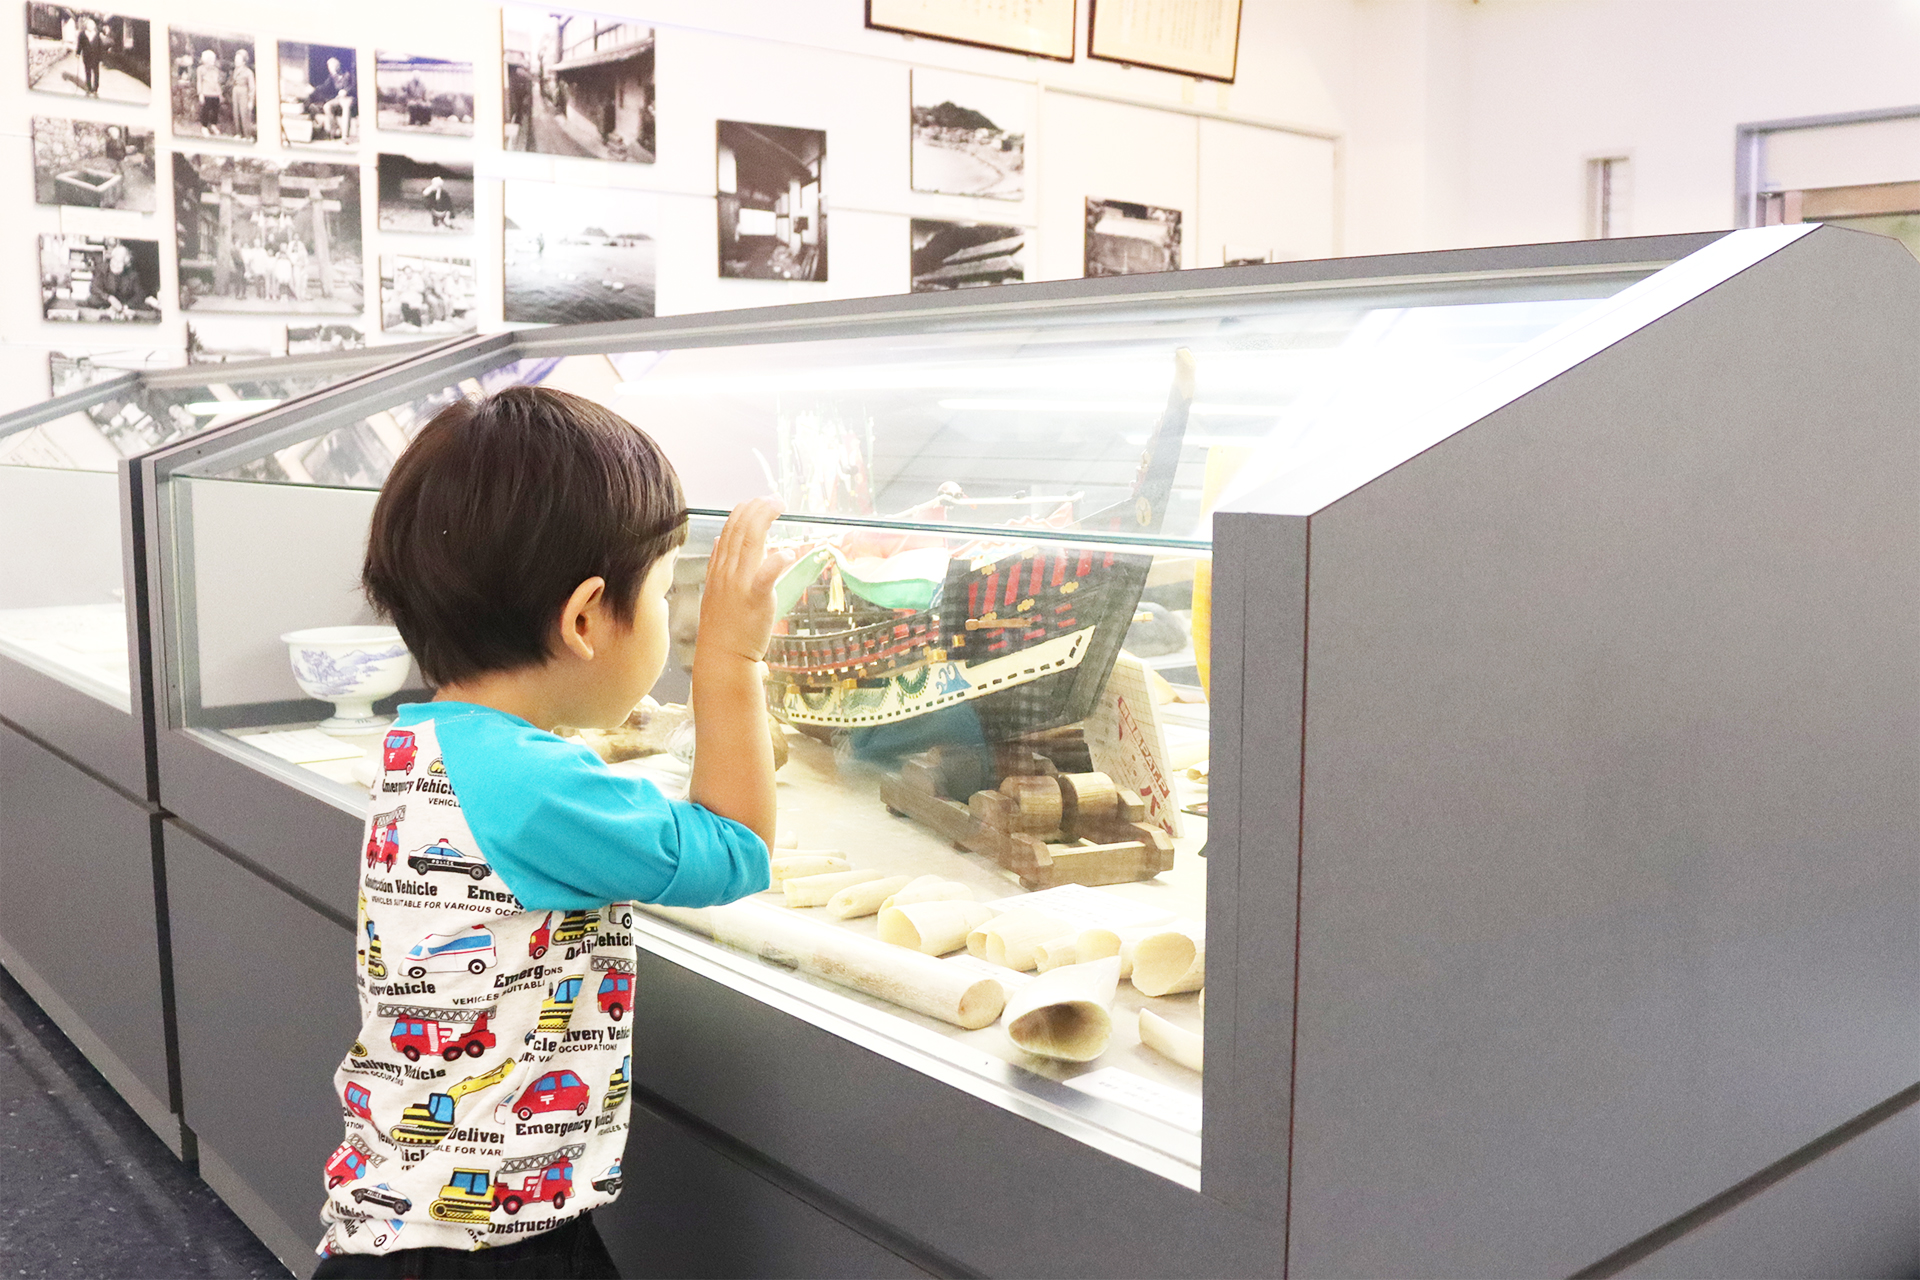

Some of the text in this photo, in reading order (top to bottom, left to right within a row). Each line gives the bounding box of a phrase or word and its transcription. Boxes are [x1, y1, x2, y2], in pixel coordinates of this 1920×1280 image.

[428, 797, 461, 808] VEHICL
[395, 879, 438, 896] Vehicle
[424, 901, 441, 909] FOR
[444, 902, 491, 913] VARIOUS
[494, 964, 544, 989] Emerg
[350, 1058, 401, 1078] Delivery
[516, 1119, 592, 1137] Emergency
[455, 1146, 475, 1155] FOR
